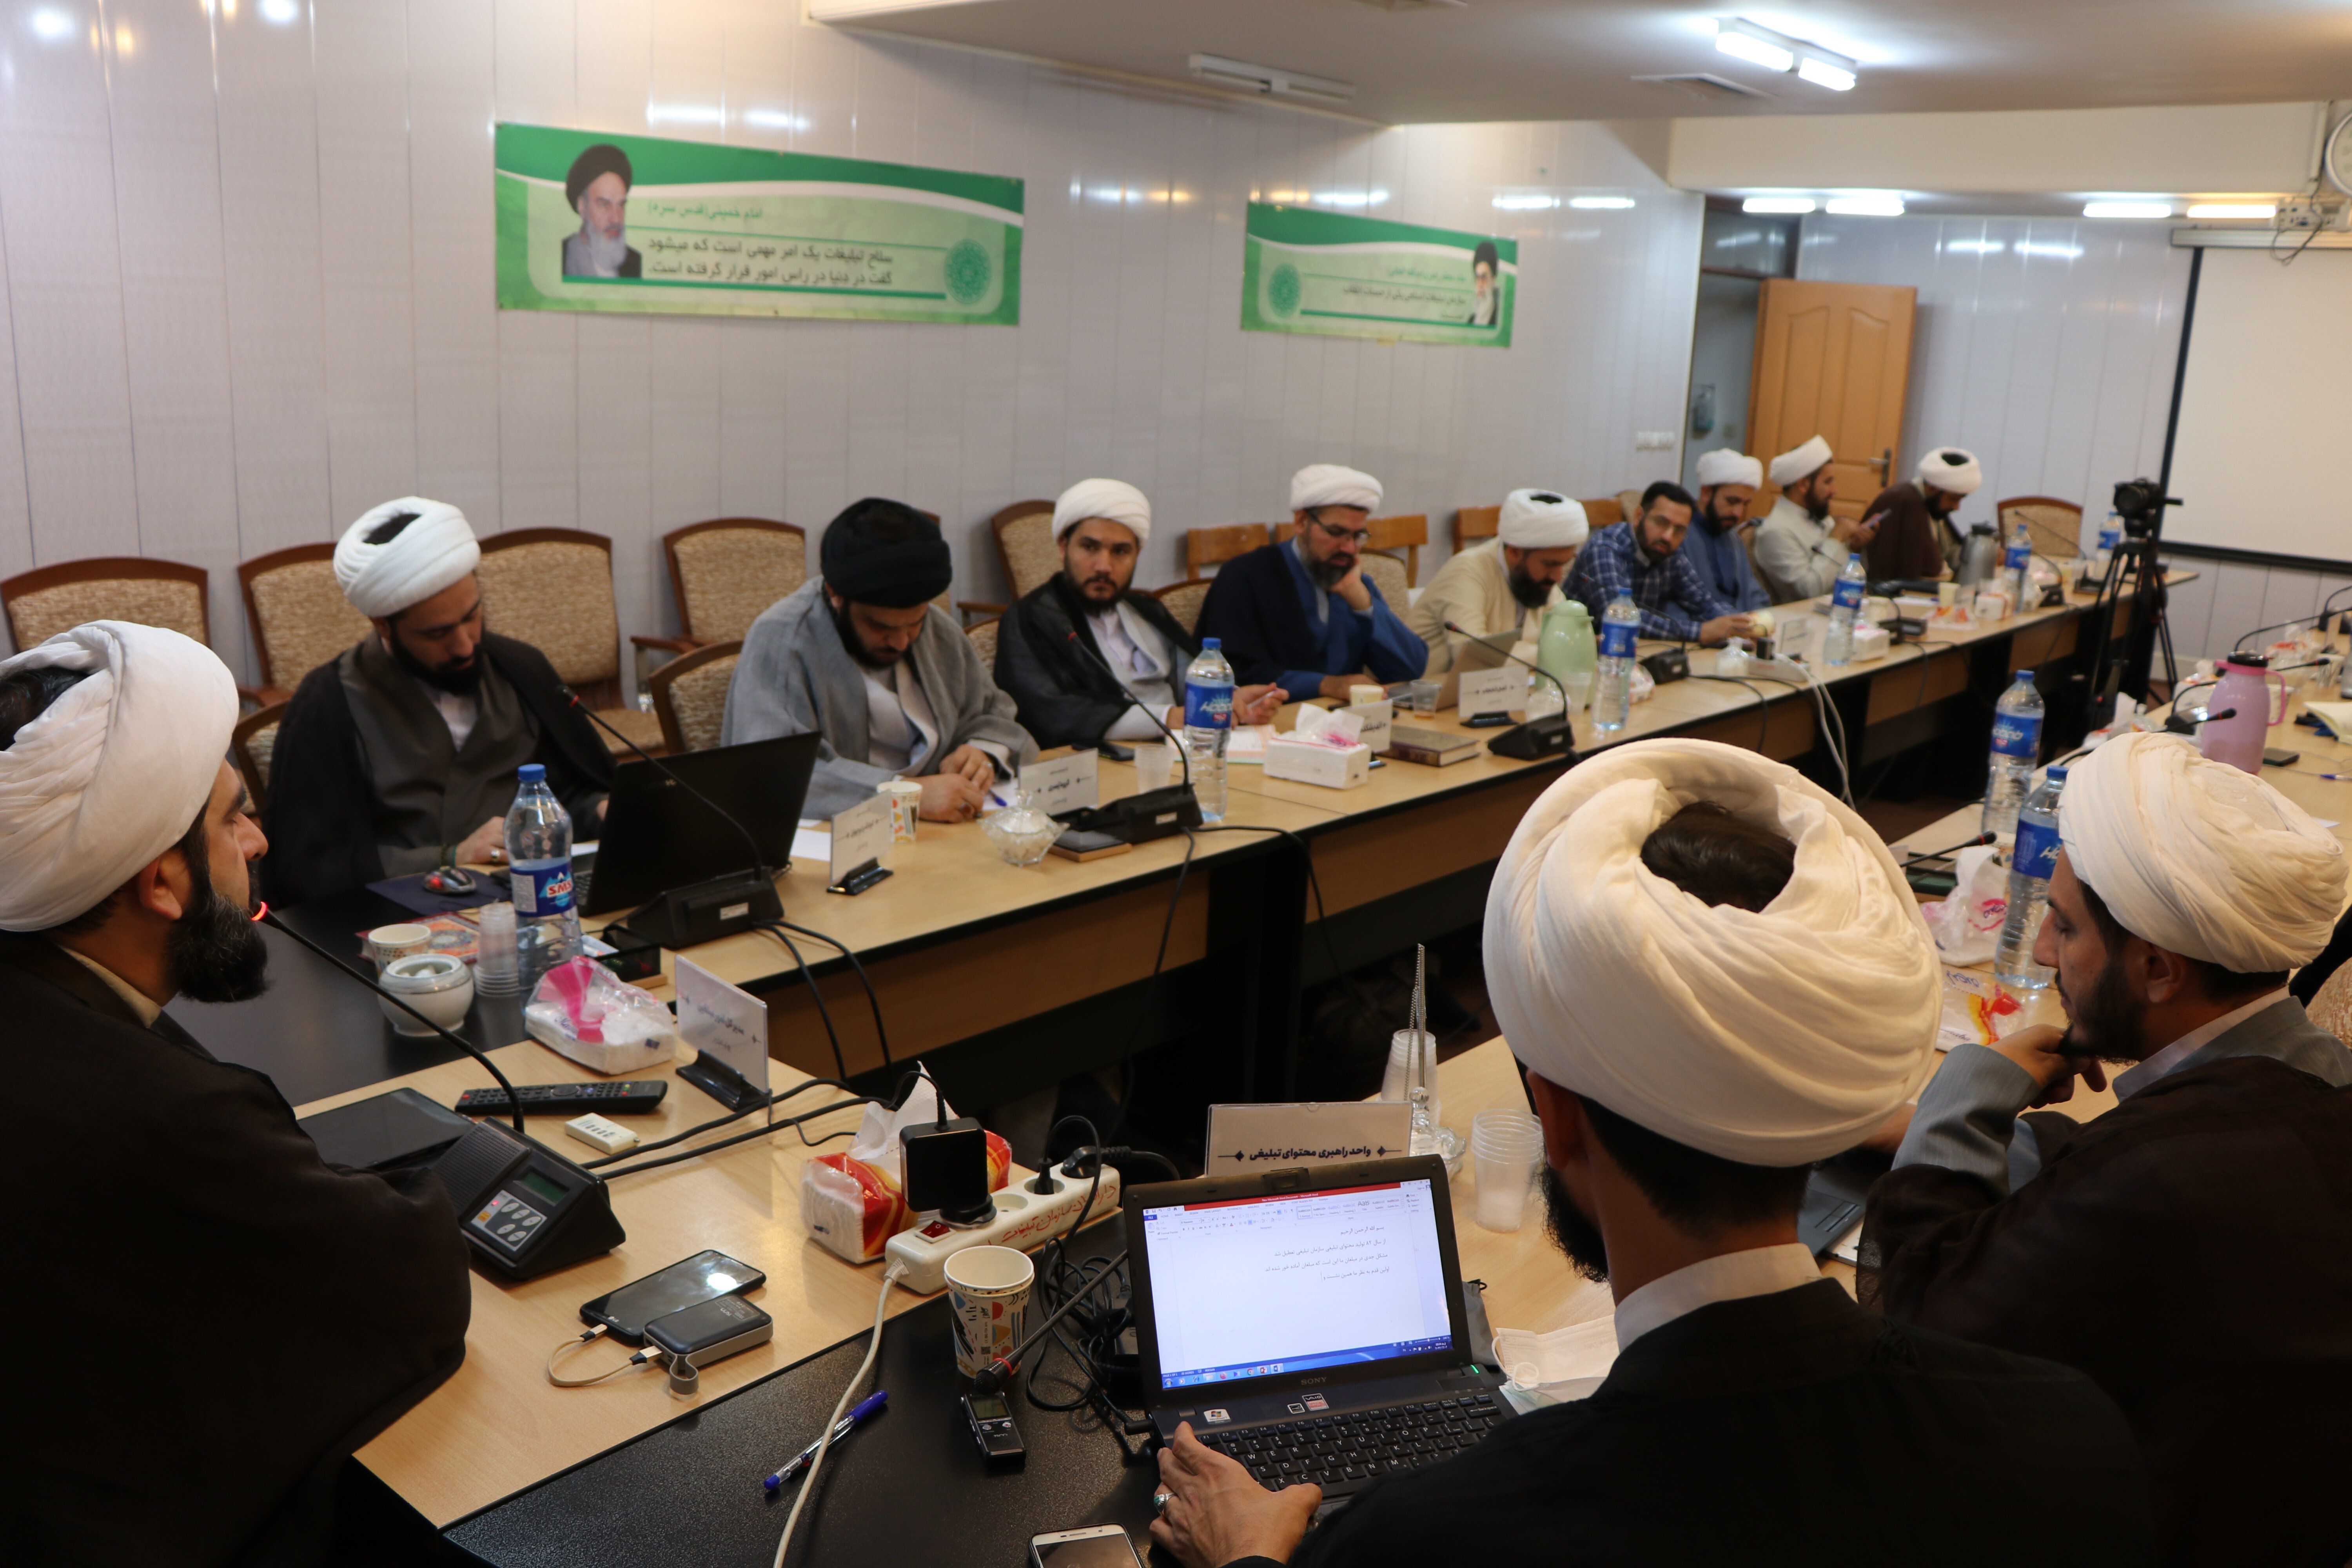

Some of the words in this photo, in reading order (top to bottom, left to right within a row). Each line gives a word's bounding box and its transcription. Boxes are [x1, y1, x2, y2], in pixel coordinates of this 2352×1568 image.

[693, 238, 709, 251] که
[713, 239, 742, 253] است
[824, 247, 865, 263] تبلیغات
[547, 878, 573, 897] SMS
[1249, 1148, 1282, 1161] تبلیغی
[1282, 1148, 1316, 1160] محتوای
[1318, 1147, 1348, 1159] راهبری
[1349, 1145, 1371, 1157] واحد
[1340, 1228, 1353, 1236] الرحیم
[1354, 1226, 1368, 1234] الرحمن
[1310, 1246, 1325, 1254] سازمان
[1326, 1244, 1339, 1252] تبلیغی
[1379, 1266, 1390, 1274] اولین
[1301, 1376, 1327, 1385] SONY
